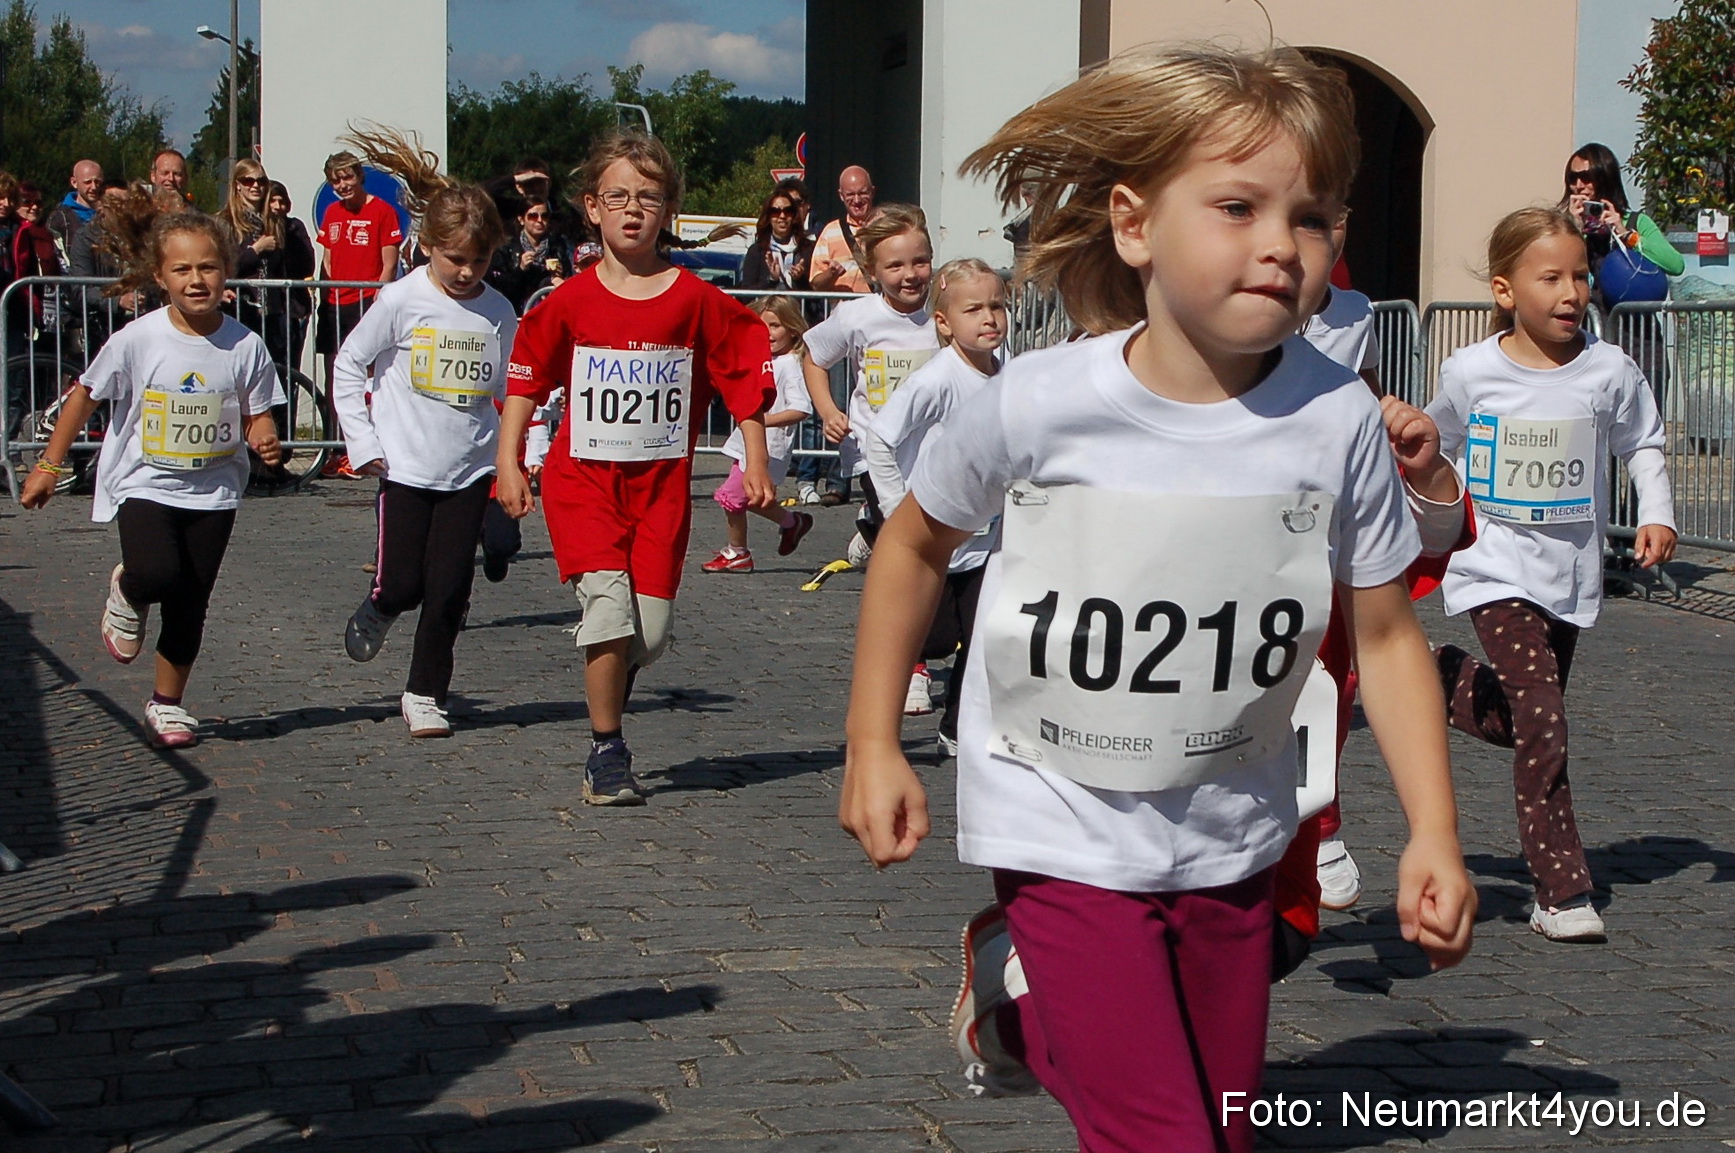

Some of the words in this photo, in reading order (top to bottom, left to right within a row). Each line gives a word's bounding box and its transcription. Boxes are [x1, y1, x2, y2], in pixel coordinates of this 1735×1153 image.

[439, 335, 486, 352] Jennifer
[628, 341, 640, 350] 11.
[440, 359, 493, 382] 7059
[587, 355, 687, 384] MARIKE
[887, 355, 912, 370] Lucy
[171, 400, 208, 415] Laura
[580, 387, 683, 424] 10216
[172, 422, 232, 444] 7003
[1504, 427, 1558, 447] Isabell
[1505, 459, 1585, 488] 7069
[1545, 505, 1591, 517] PFLEIDERER
[1019, 590, 1304, 694] 10218
[1062, 727, 1153, 751] PFLEIDERER
